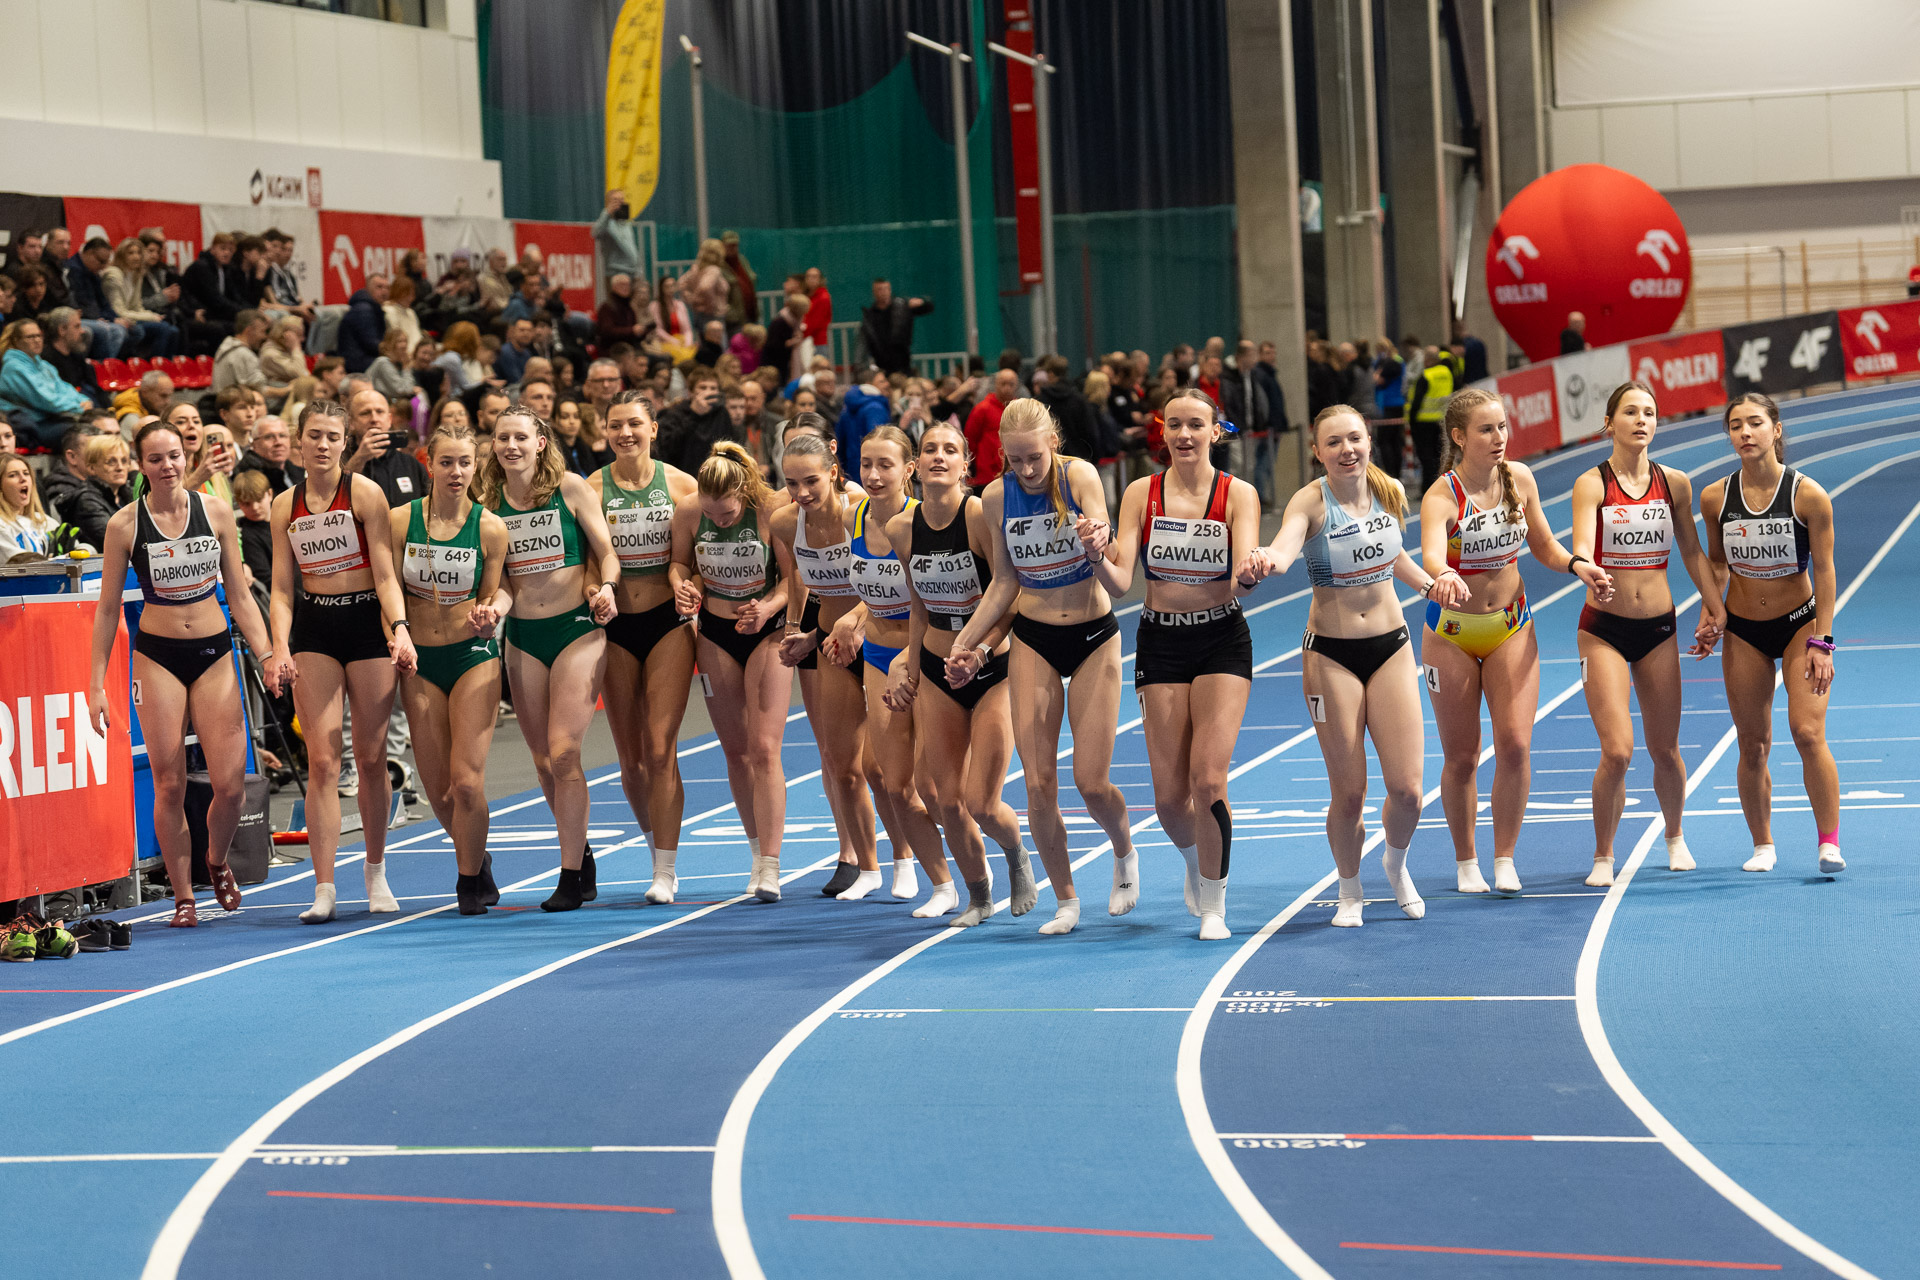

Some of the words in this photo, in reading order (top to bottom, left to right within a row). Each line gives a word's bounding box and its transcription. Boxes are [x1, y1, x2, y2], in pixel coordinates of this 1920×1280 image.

[1628, 278, 1684, 299] ORLEN
[1790, 325, 1832, 372] 4F
[1732, 336, 1771, 383] 4F
[1853, 352, 1898, 375] ORLEN
[1662, 352, 1720, 390] ORLEN
[607, 498, 625, 508] 4F
[323, 513, 346, 528] 447
[530, 513, 554, 528] 647
[645, 509, 670, 523] 422
[1642, 508, 1666, 520] 672
[1009, 519, 1033, 536] 4F
[1193, 524, 1222, 537] 258
[1365, 515, 1392, 534] 232
[1465, 514, 1487, 532] 4F
[1758, 523, 1791, 535] 1301
[611, 529, 672, 548] ODOLIŃSKA
[700, 530, 719, 541] 4F
[1464, 528, 1526, 554] RATAJCZAK
[1613, 530, 1664, 545] KOZAN
[185, 539, 219, 554] 1292
[300, 535, 348, 556] SIMON
[506, 534, 561, 555] LESZNO
[732, 545, 757, 557] 427
[1353, 542, 1384, 563] KOS
[1731, 545, 1789, 559] RUDNIK
[444, 550, 471, 563] 649
[825, 546, 850, 561] 299
[1150, 545, 1225, 564] GAWLAK
[153, 560, 217, 583] DĄBKOWSKA
[700, 563, 764, 579] POLKOWSKA
[852, 560, 868, 574] 4F
[877, 563, 901, 576] 949
[913, 558, 933, 573] 4F
[938, 556, 973, 572] 1013
[1061, 564, 1077, 573] 2025
[420, 569, 459, 585] LACH
[807, 567, 850, 580] KANIA
[1345, 573, 1380, 585] WROCŁAW
[857, 582, 901, 598] CIEŚLA
[915, 578, 978, 594] ROSZKOWSKA
[314, 595, 352, 606] NIKE
[355, 592, 378, 603] PR
[1160, 599, 1238, 626] UNDER
[1790, 605, 1808, 621] NIKE
[1427, 669, 1436, 690] 4
[132, 681, 140, 703] 2
[1310, 697, 1320, 720] 7
[0, 688, 108, 799] RLEN
[1233, 1139, 1367, 1149] 4x200
